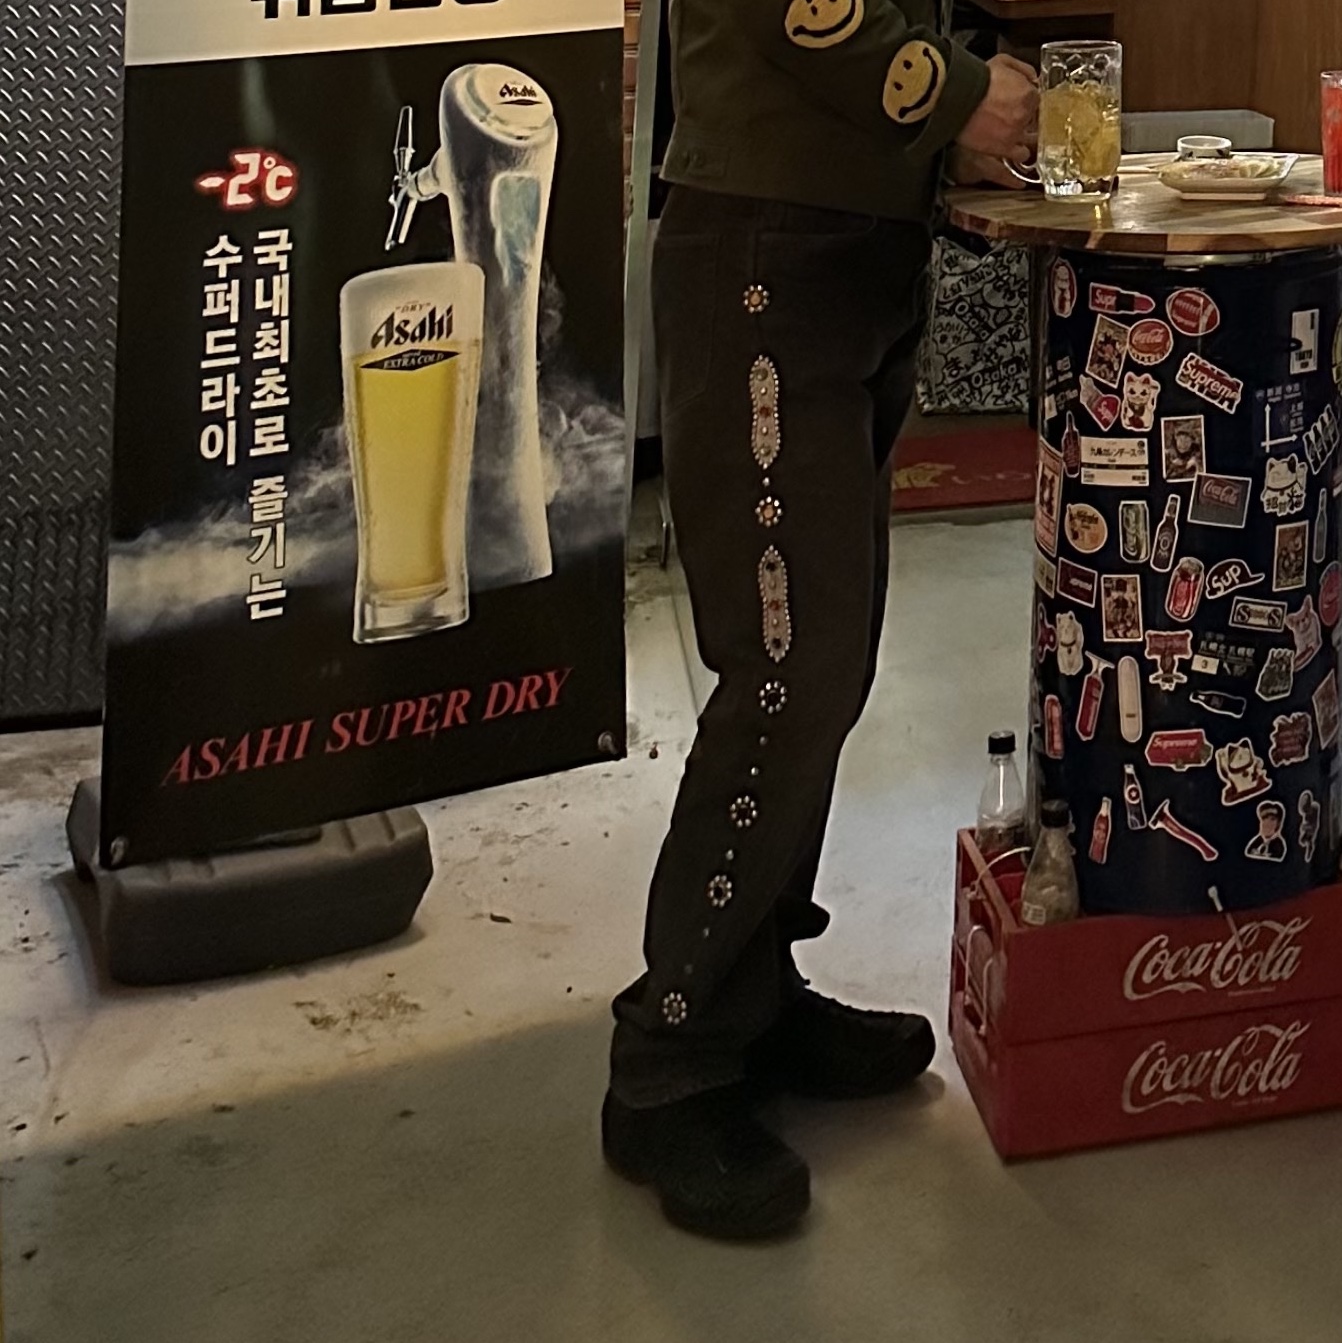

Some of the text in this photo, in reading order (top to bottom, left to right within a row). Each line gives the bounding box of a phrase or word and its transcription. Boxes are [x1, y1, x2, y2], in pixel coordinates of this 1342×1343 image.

[499, 84, 537, 98] Asahi
[199, 234, 243, 467] 수퍼드라이
[370, 304, 453, 349] Asahi
[383, 356, 416, 369] EXTRA
[417, 352, 445, 366] COLD
[970, 361, 1018, 388] Osaka
[1183, 359, 1240, 400] Supreme
[245, 227, 293, 621] 국내최초로 즐기는
[161, 667, 574, 787] ASAHI SUPER DRY
[1123, 914, 1314, 1001] Coca-Cola
[1122, 1020, 1313, 1114] Coca-Cola
